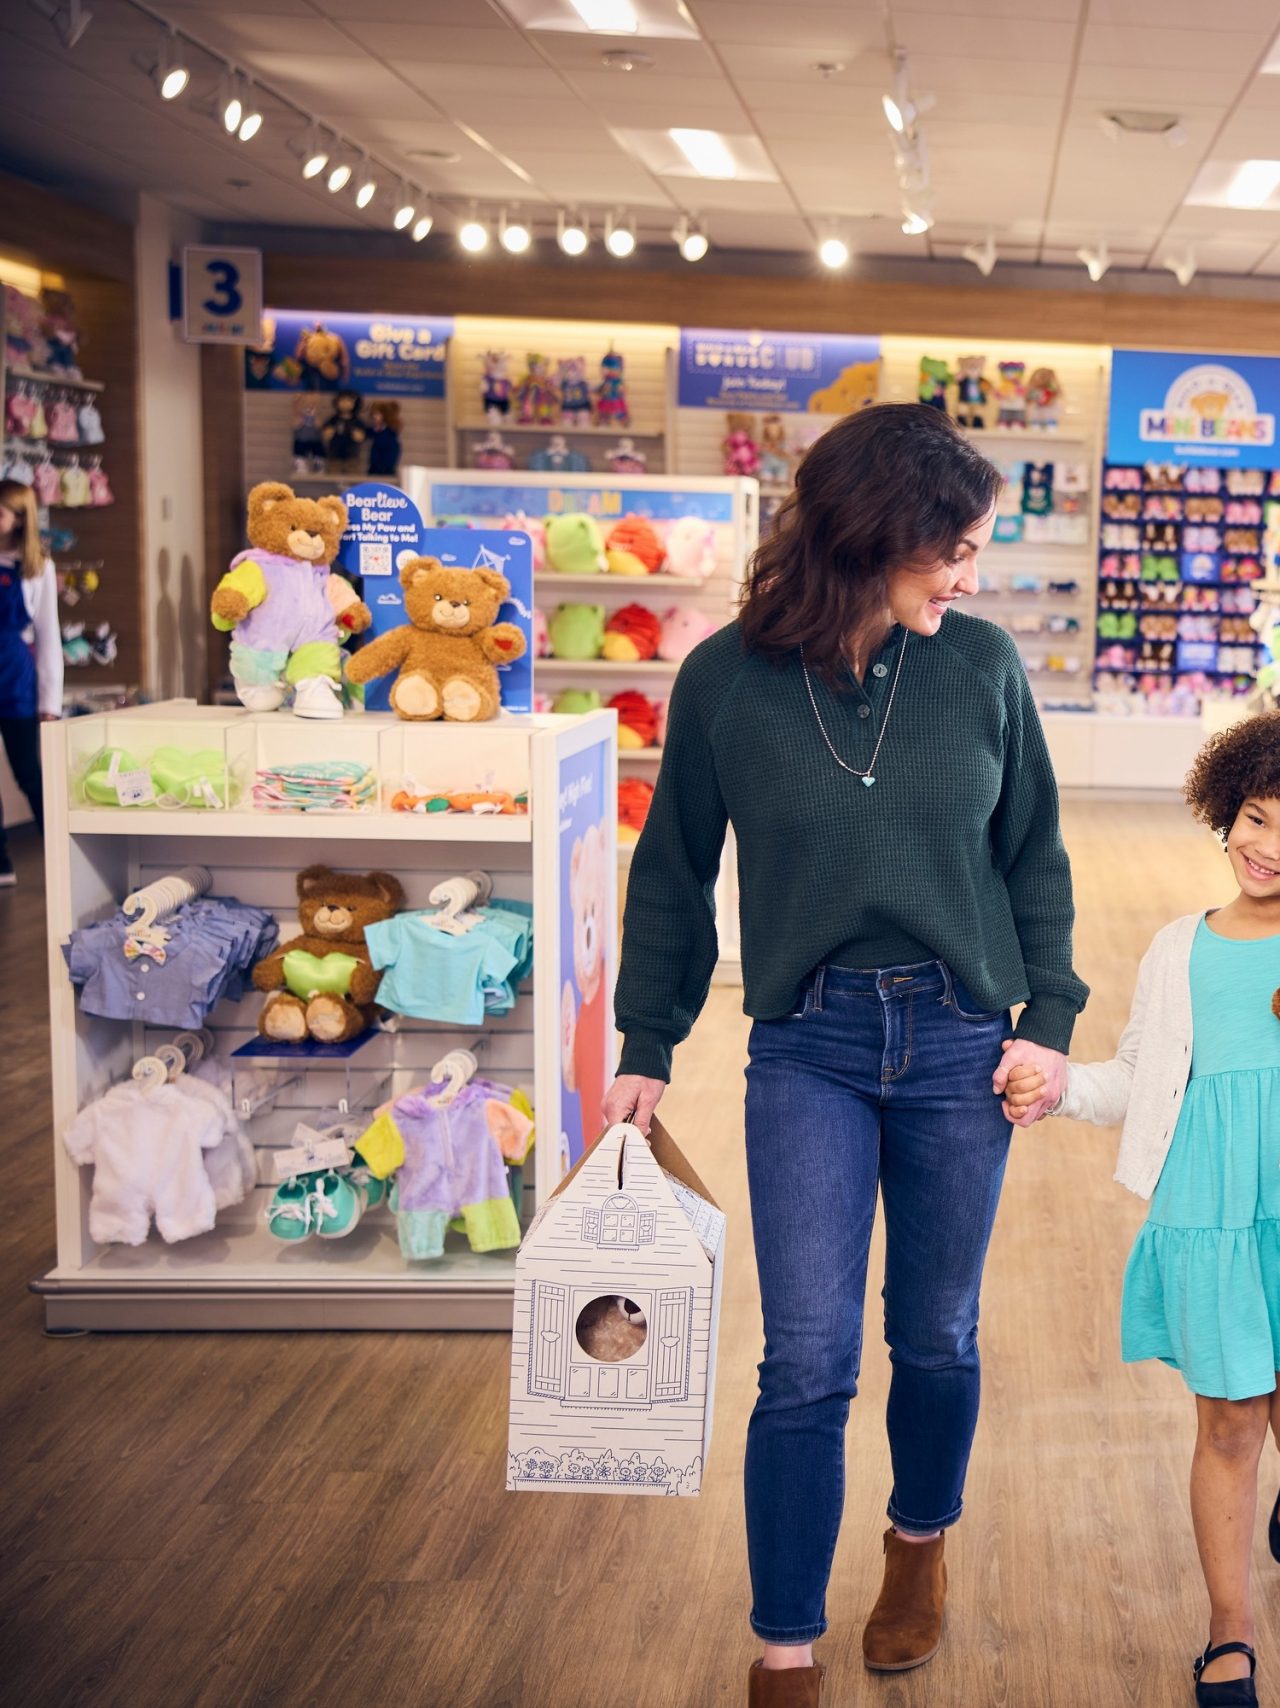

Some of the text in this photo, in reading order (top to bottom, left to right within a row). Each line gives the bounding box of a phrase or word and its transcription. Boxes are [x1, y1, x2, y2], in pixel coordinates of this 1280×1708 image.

[203, 260, 243, 316] 3
[369, 322, 415, 345] Give
[355, 339, 446, 362] Gift Card
[361, 507, 393, 523] Bear
[362, 522, 377, 534] My
[377, 523, 397, 532] Paw
[397, 523, 416, 533] and
[357, 532, 389, 544] Talking
